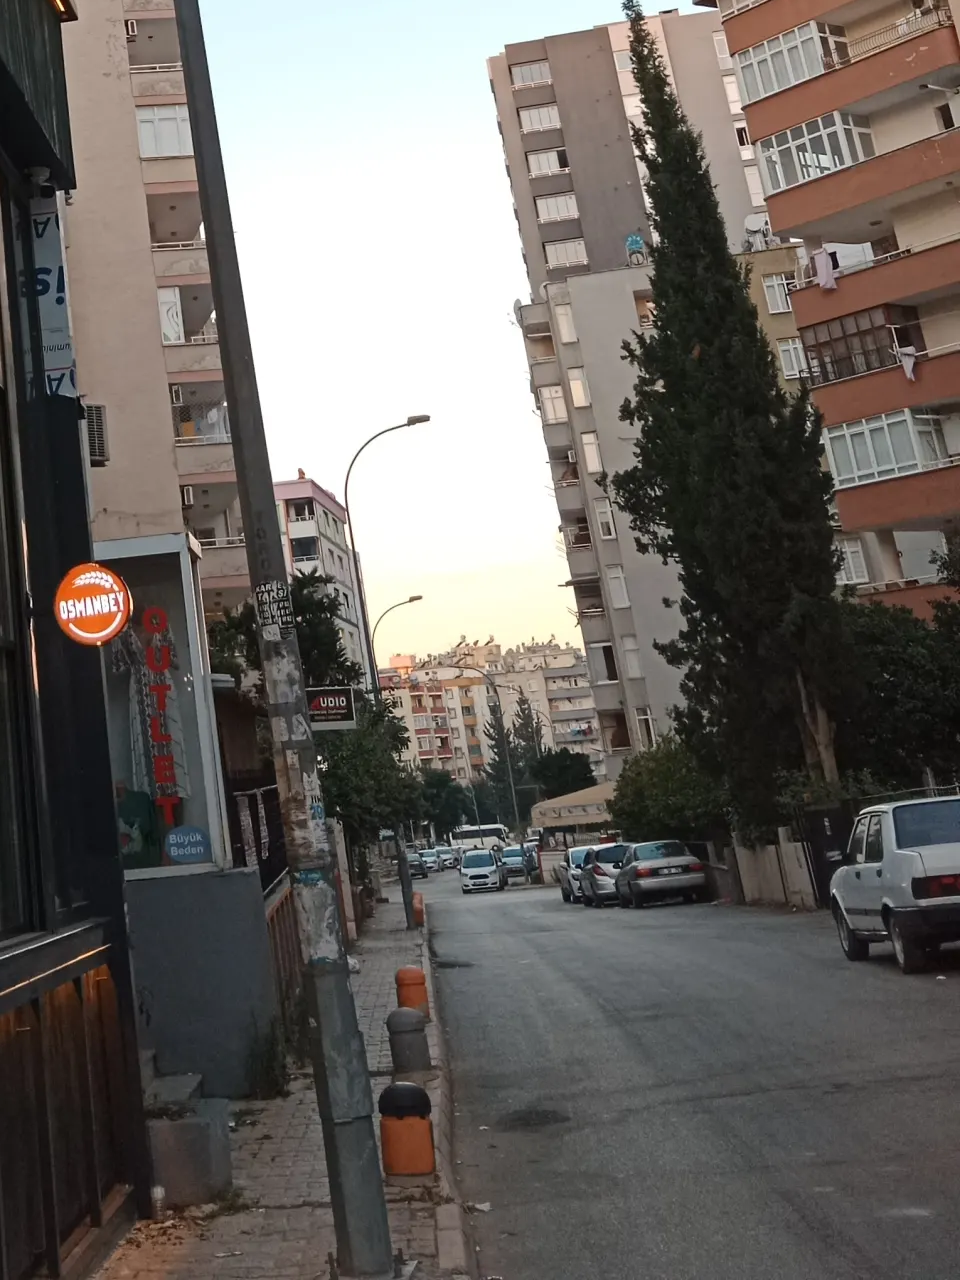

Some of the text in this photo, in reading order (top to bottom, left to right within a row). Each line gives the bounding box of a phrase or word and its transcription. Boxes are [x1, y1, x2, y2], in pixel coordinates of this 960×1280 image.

[59, 591, 125, 619] OSMANBEY
[142, 607, 181, 825] OUTLET
[169, 832, 204, 845] Büyük
[170, 845, 204, 856] Beden
